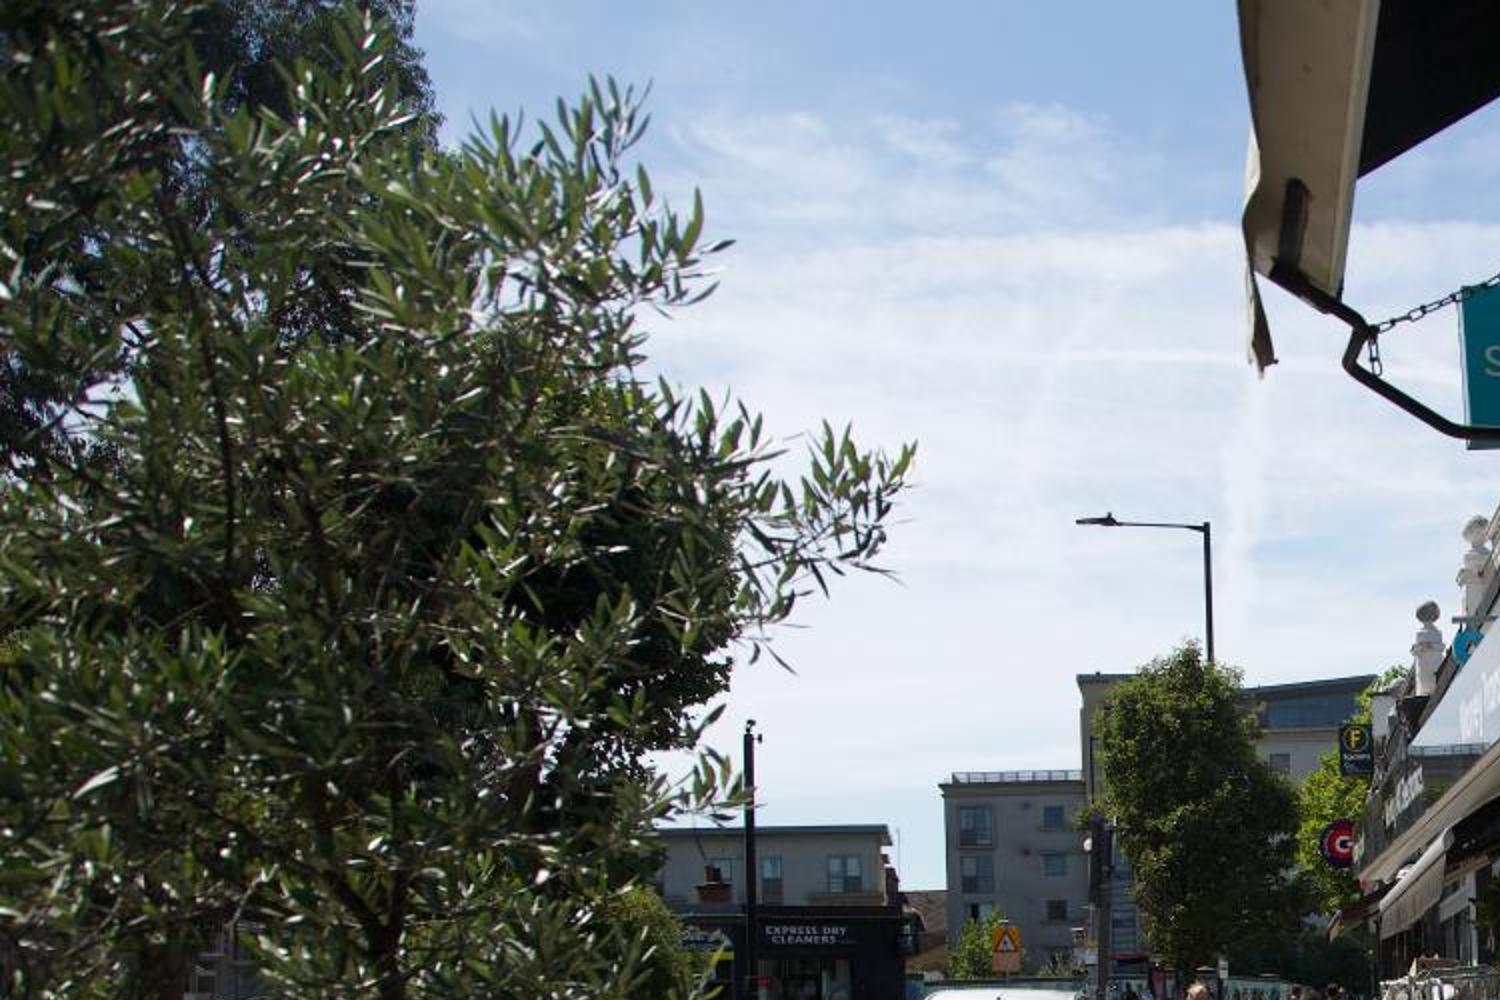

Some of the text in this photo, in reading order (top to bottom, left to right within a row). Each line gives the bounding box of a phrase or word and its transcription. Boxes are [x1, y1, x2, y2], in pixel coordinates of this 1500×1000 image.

[764, 925, 847, 938] EXPRESS DRY
[771, 935, 837, 945] CLEANERS
